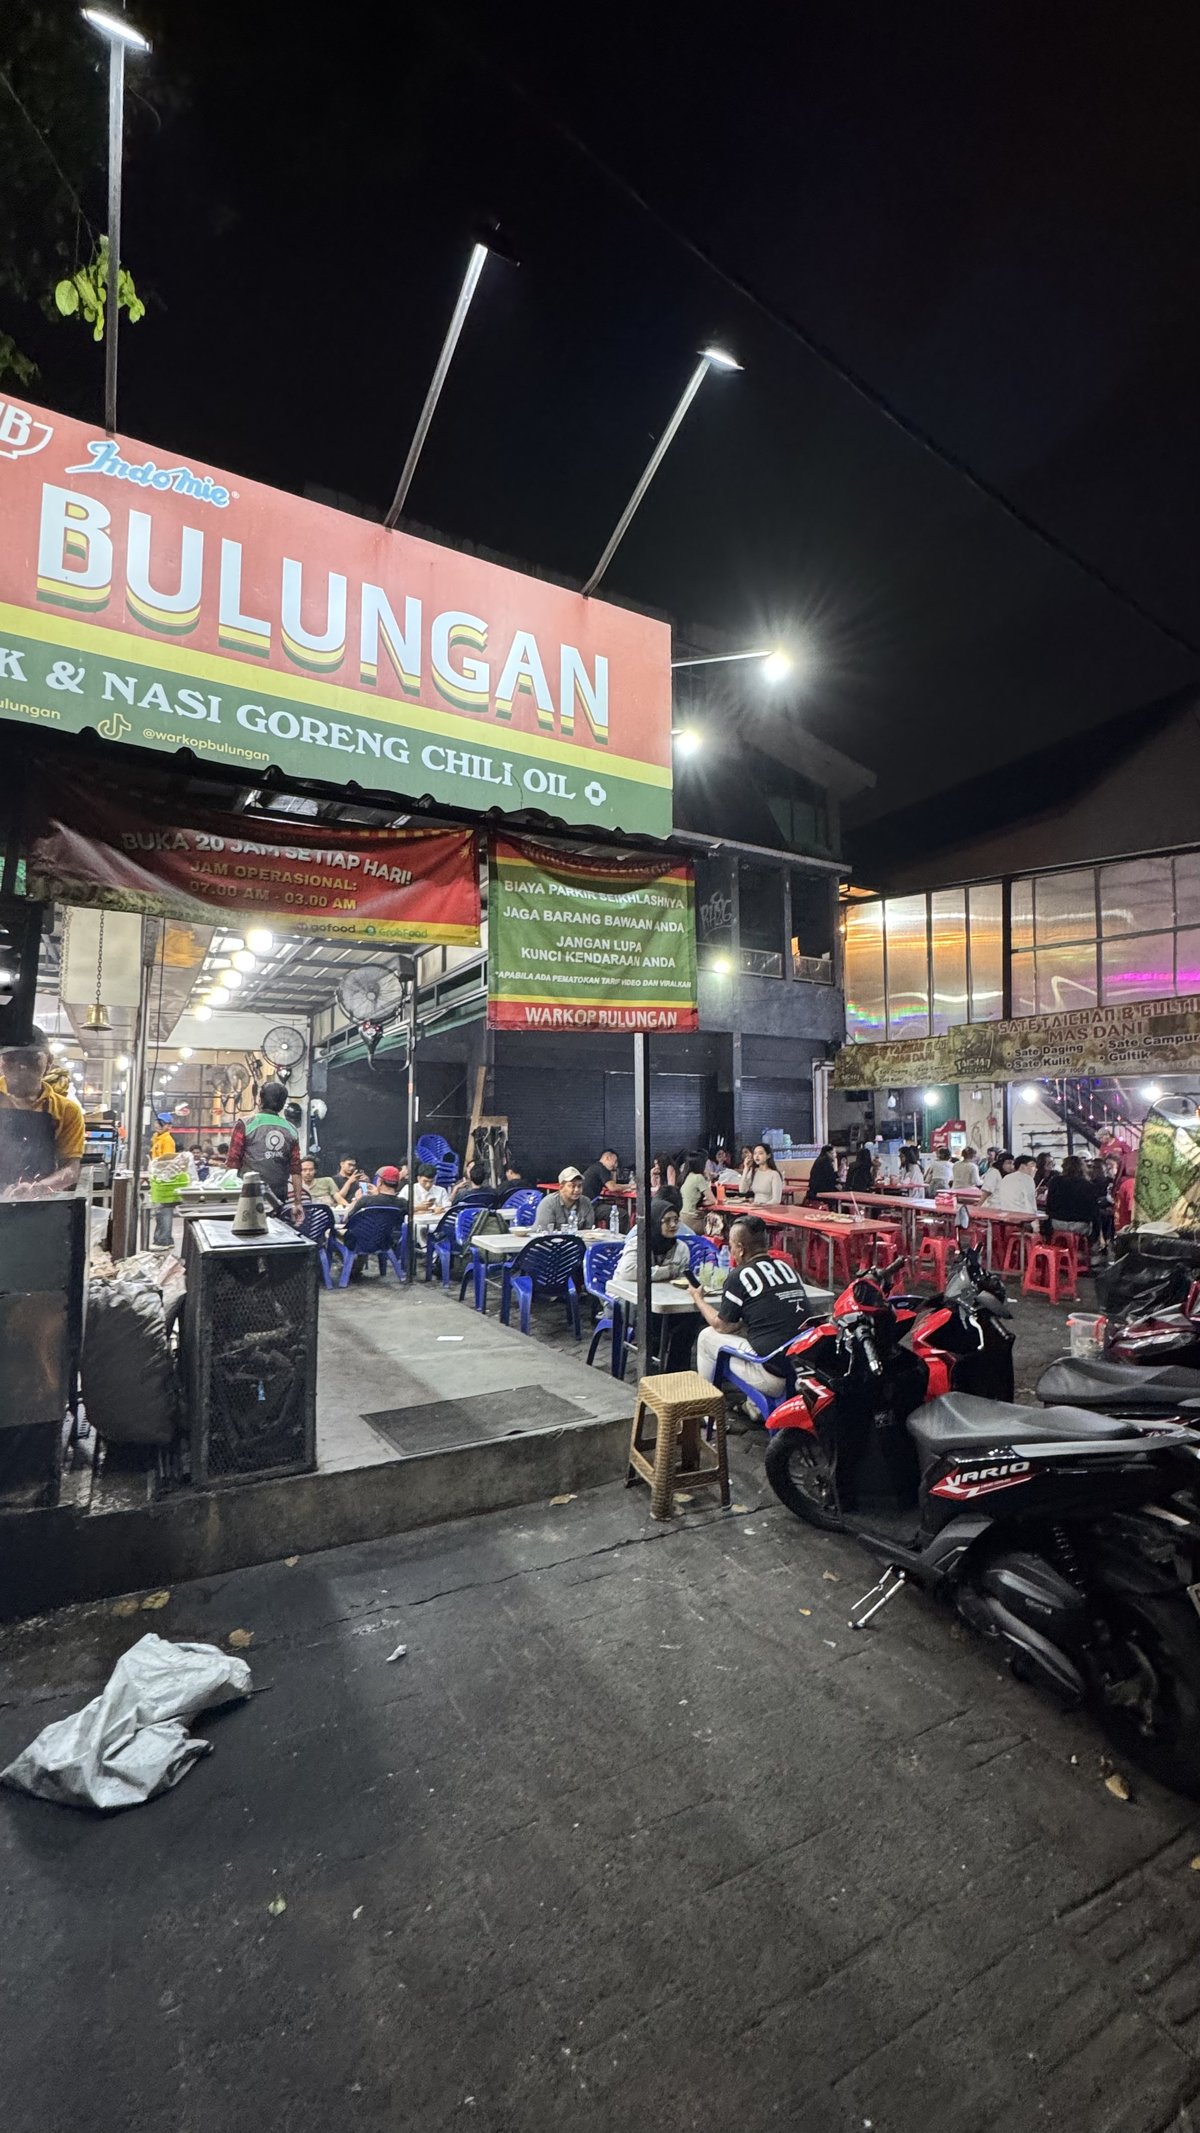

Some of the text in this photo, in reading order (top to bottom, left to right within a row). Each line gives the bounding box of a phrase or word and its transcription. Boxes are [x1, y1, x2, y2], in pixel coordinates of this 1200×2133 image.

[37, 483, 608, 744] BULUNGAN
[46, 661, 86, 694] &
[101, 671, 222, 723] NASI
[236, 704, 410, 765] GORENG
[421, 745, 513, 787] CHILI
[523, 768, 576, 800] OIL
[142, 728, 270, 762] @warkopbulungan
[122, 832, 190, 851] BUKA
[194, 834, 225, 852] 20
[285, 847, 361, 870] SETIAP
[363, 859, 413, 885] HARI!
[190, 861, 358, 892] JAM OPERASIONAL:
[190, 880, 237, 897] 07.00
[243, 887, 270, 901] AM
[284, 892, 328, 908] 03.00
[332, 898, 356, 910] AM
[504, 880, 545, 895] BIAYA
[548, 884, 599, 900] PARKIR
[311, 923, 356, 934] gofood
[503, 906, 685, 933] JAGA BARANG BAWAAN ANDA
[379, 927, 428, 939] GrabFood
[556, 936, 642, 953] JANGAN LUPA
[521, 947, 676, 968] KUNCI KENDARAAN ANDA
[535, 974, 551, 982] ADA
[642, 979, 659, 987] DAN
[525, 1007, 677, 1028] WARKOP BULUNGAN
[1000, 1000, 1200, 1034] SATE TAICHAN & GULTI
[1049, 1021, 1142, 1042] MAS DANI
[1108, 1034, 1199, 1049] Sate Campur
[1014, 1045, 1083, 1057] Sate Daging
[1109, 1050, 1149, 1061] Gultik
[1014, 1057, 1071, 1069] Sate Kulit
[738, 1259, 798, 1298] ORD
[946, 1461, 1030, 1487] VARIO
